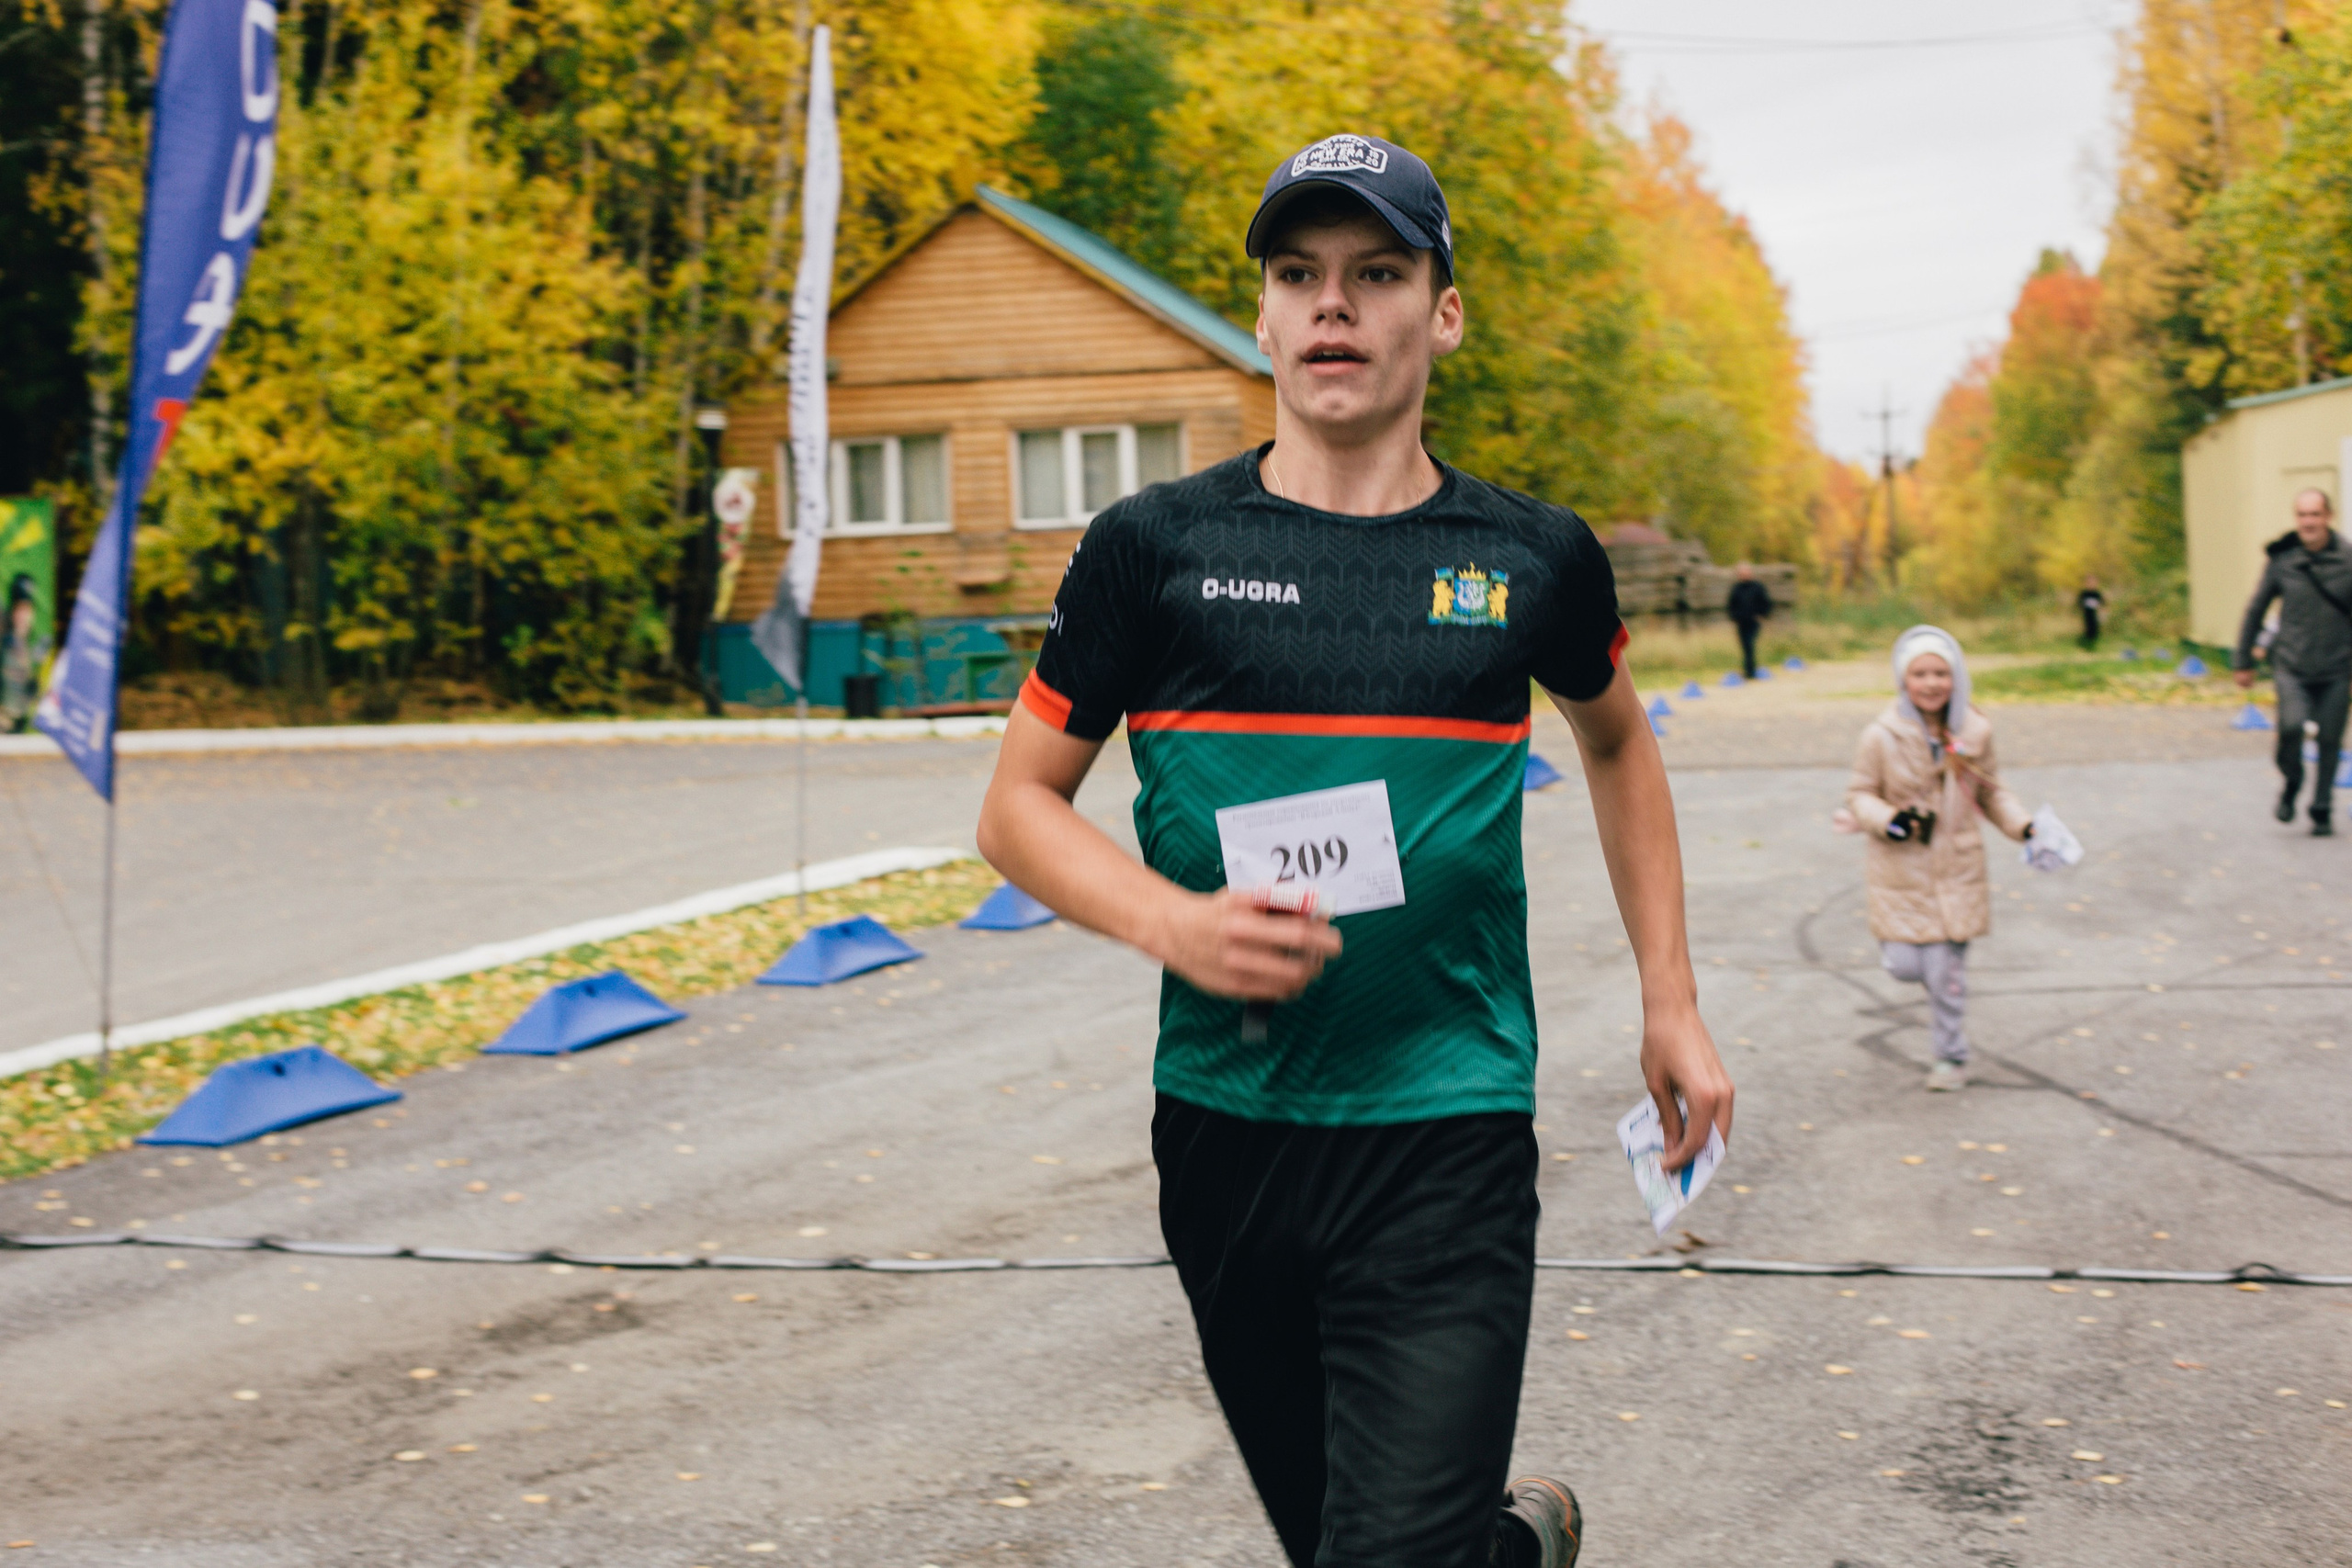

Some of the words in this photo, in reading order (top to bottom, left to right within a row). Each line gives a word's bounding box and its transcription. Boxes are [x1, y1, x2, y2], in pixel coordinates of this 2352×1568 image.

[1309, 147, 1337, 161] NEW
[1339, 148, 1364, 159] ERA
[1202, 578, 1301, 604] O-UGRA
[1271, 834, 1349, 884] 209
